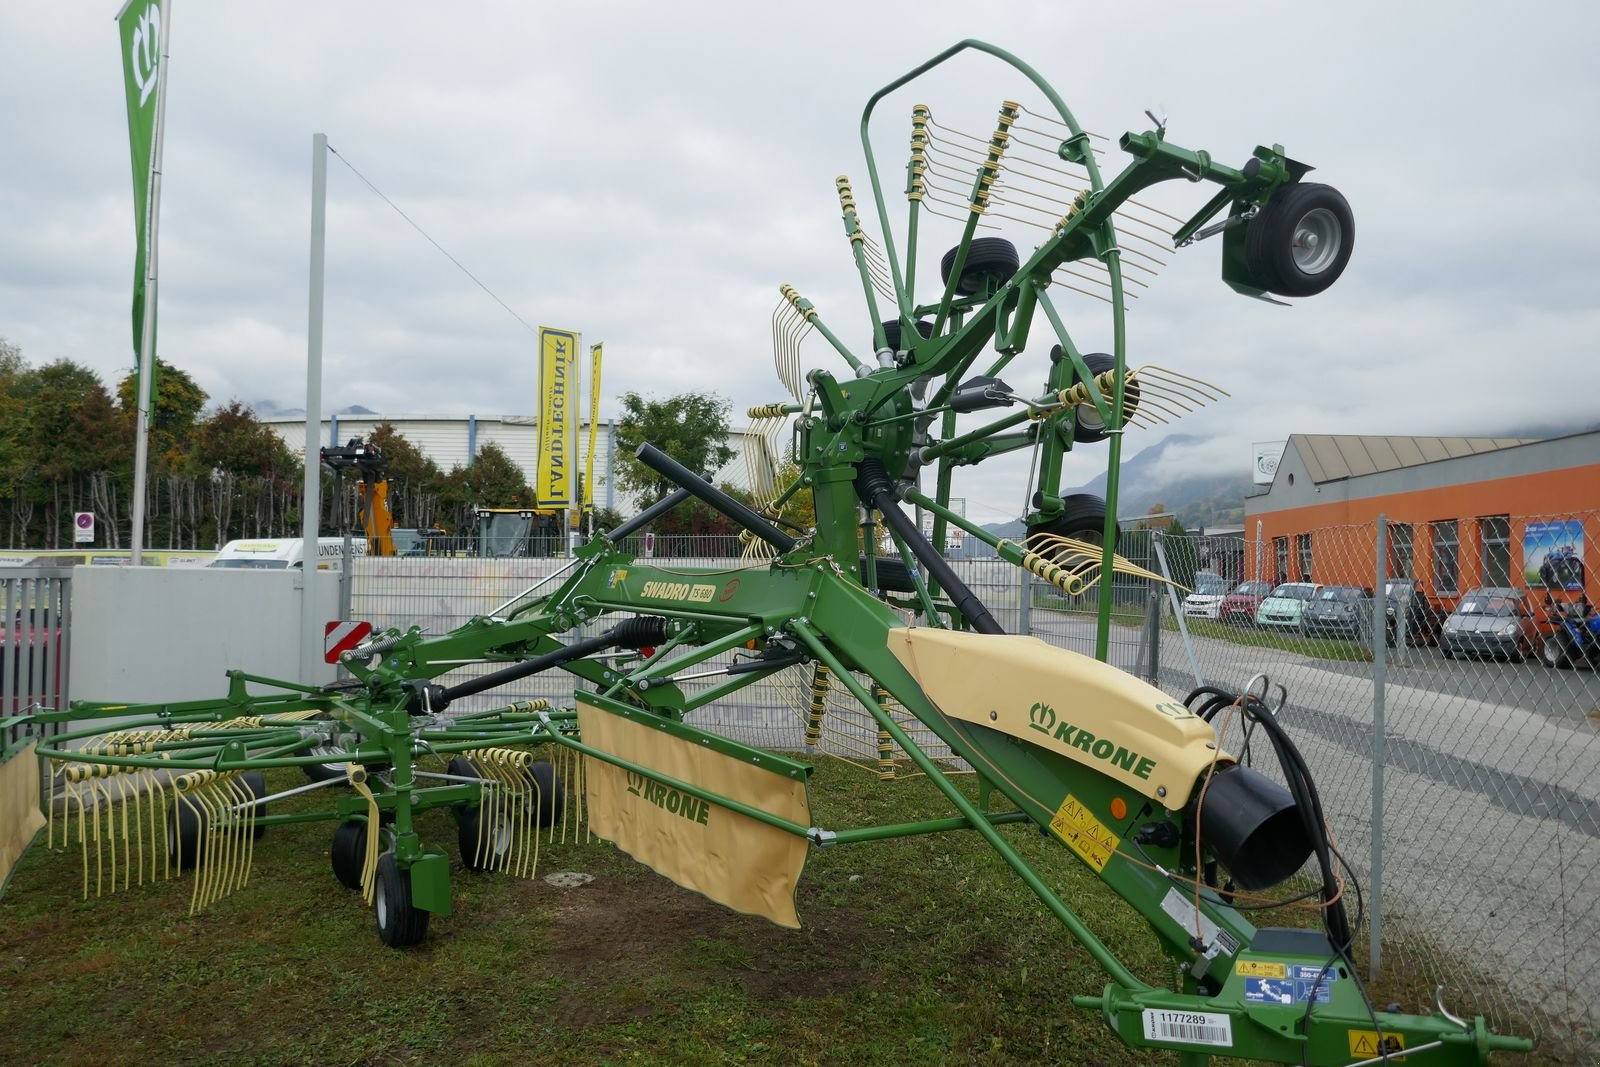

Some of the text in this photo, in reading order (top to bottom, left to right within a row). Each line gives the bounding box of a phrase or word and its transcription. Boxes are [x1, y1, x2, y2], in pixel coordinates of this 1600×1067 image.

[318, 543, 367, 556] UNDENENST
[640, 581, 690, 600] SWADRO
[692, 588, 701, 597] TS
[701, 588, 713, 599] 680
[1053, 721, 1157, 780] KRONE
[644, 779, 710, 826] KRONE
[1160, 1013, 1206, 1025] 1177289
